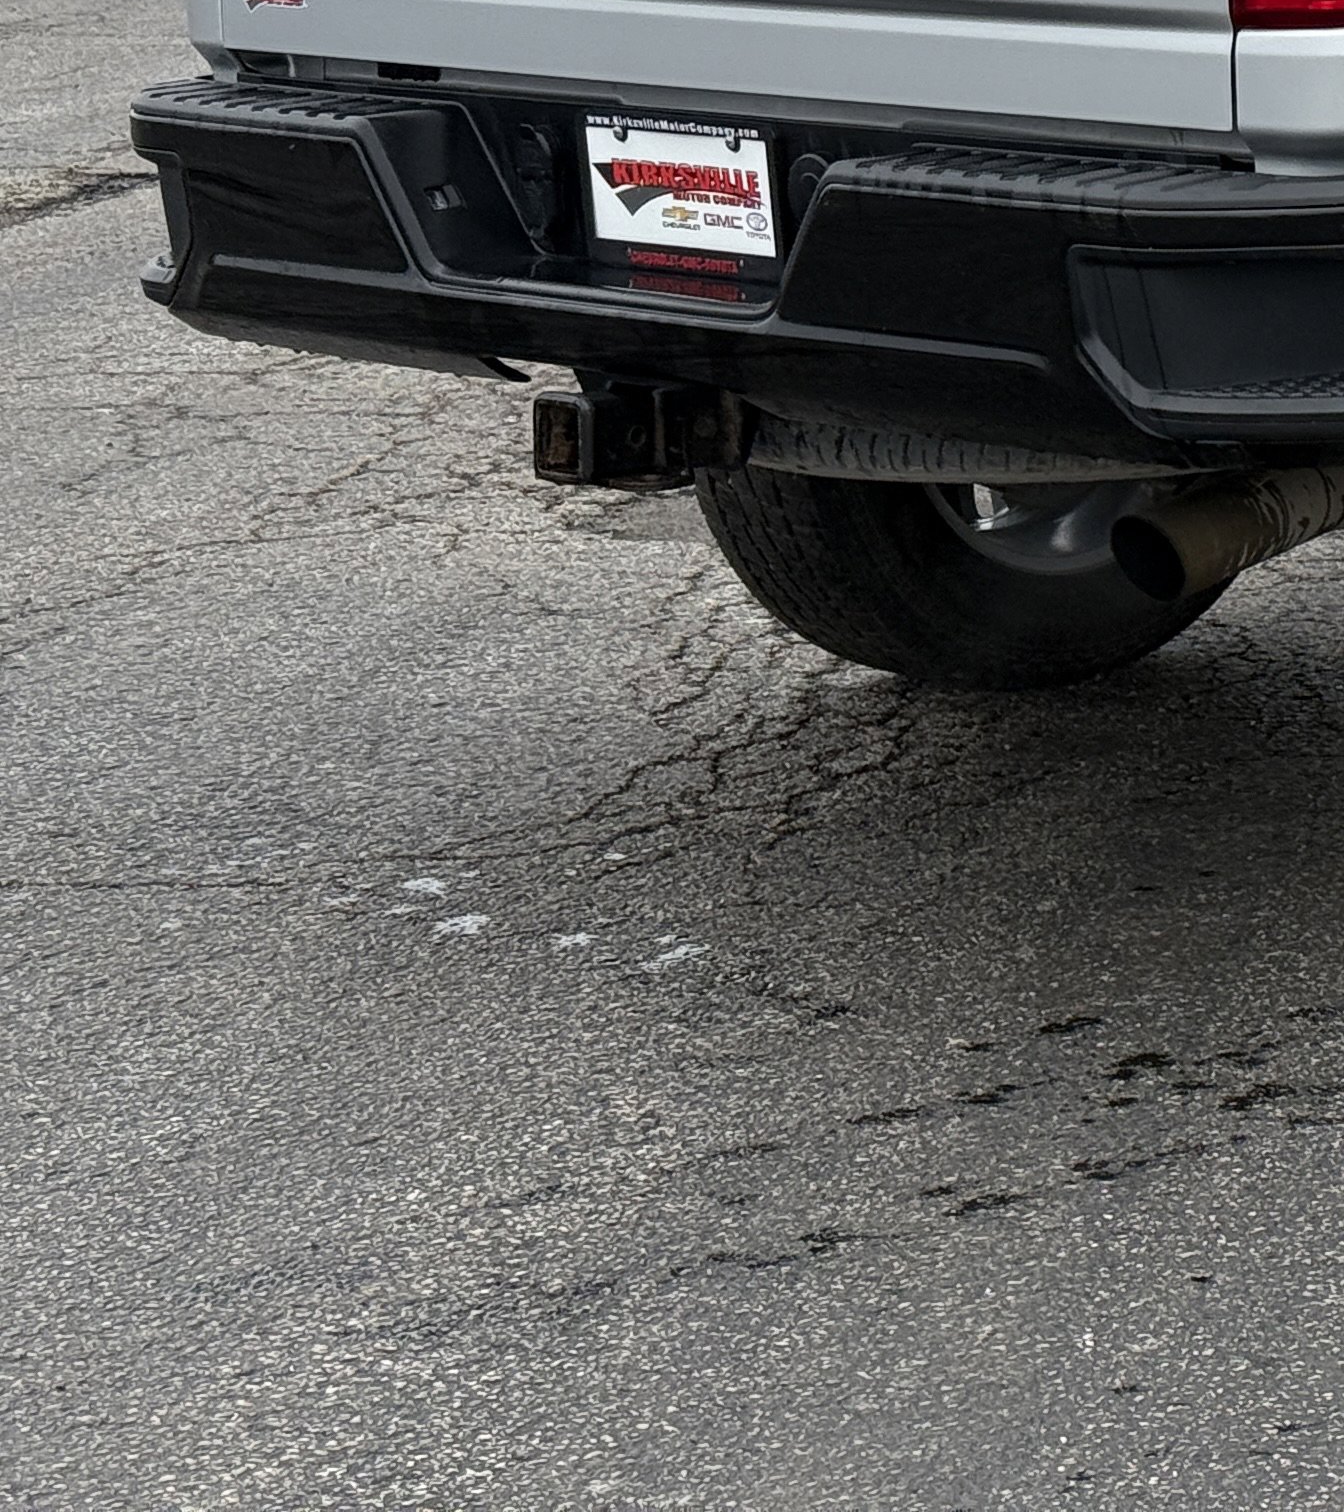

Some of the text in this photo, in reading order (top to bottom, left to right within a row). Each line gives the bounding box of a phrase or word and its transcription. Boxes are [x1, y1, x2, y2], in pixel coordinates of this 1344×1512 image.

[611, 158, 761, 199] KIRKSVILLE
[673, 190, 762, 210] MOTOR COMPANY
[704, 213, 743, 230] GMC
